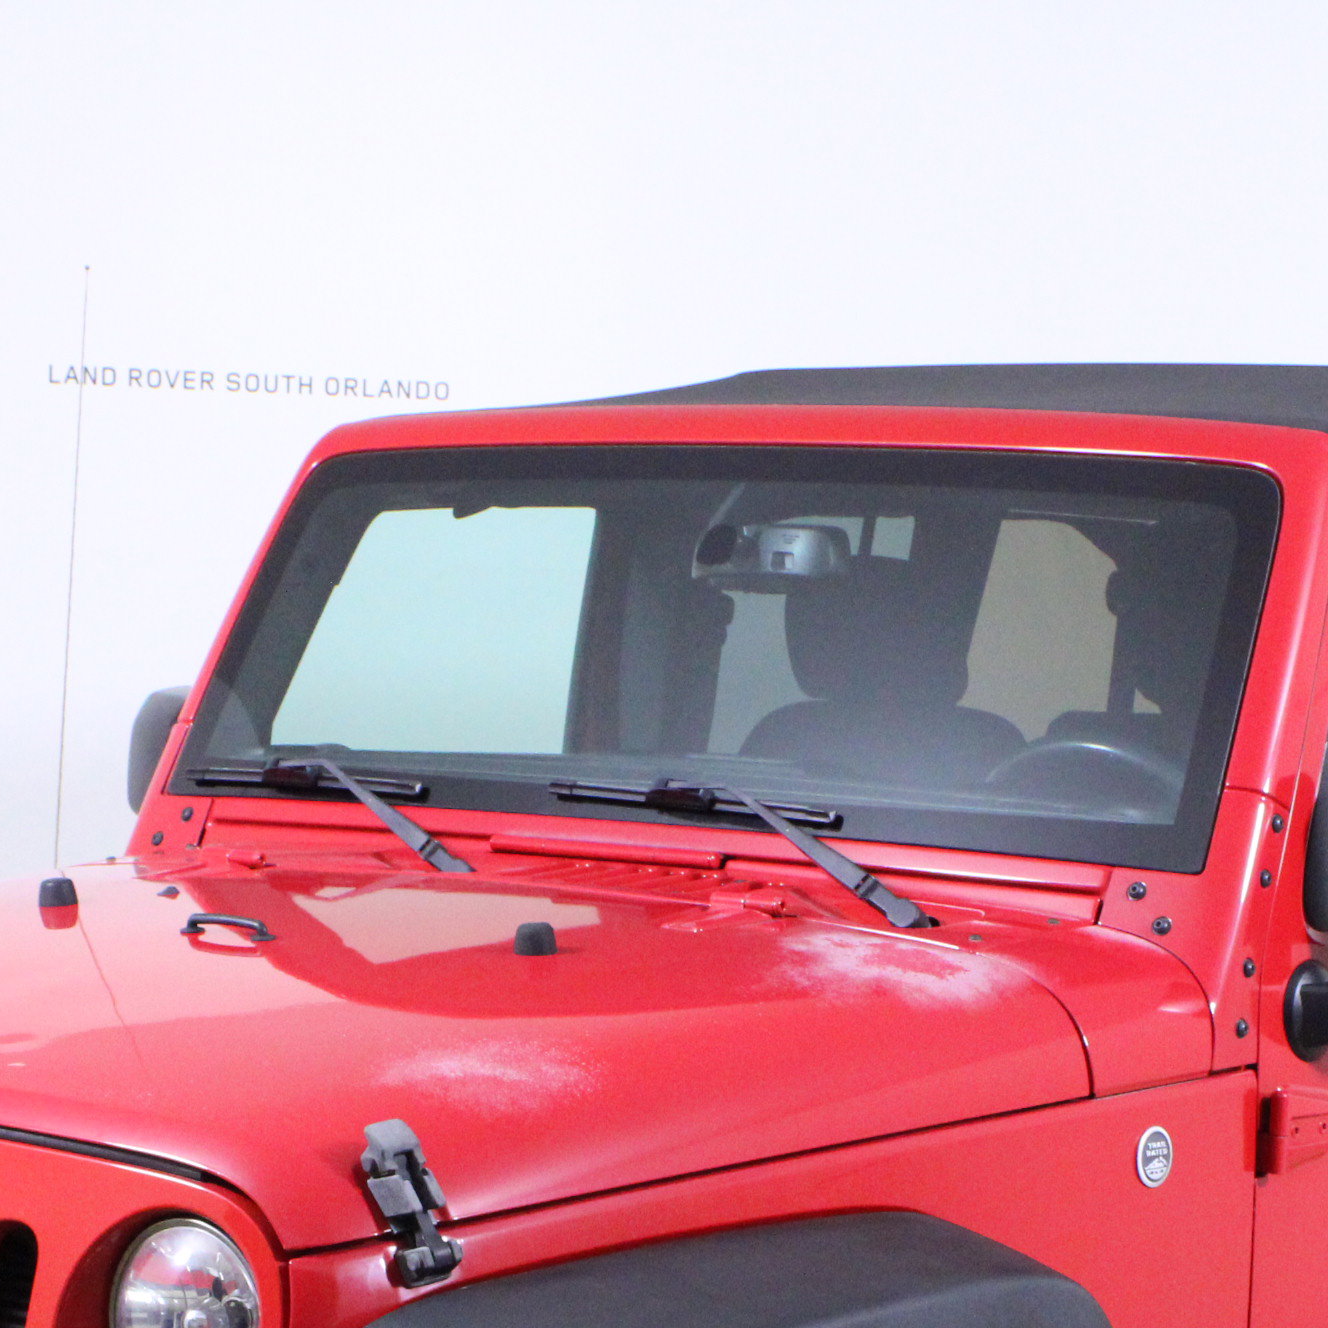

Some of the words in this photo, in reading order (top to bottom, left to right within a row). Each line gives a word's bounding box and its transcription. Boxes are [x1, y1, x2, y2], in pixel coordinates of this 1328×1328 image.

[48, 364, 117, 387] LAND
[128, 368, 215, 391] ROVER
[225, 372, 313, 395] SOUTH
[324, 377, 450, 401] ORLANDO
